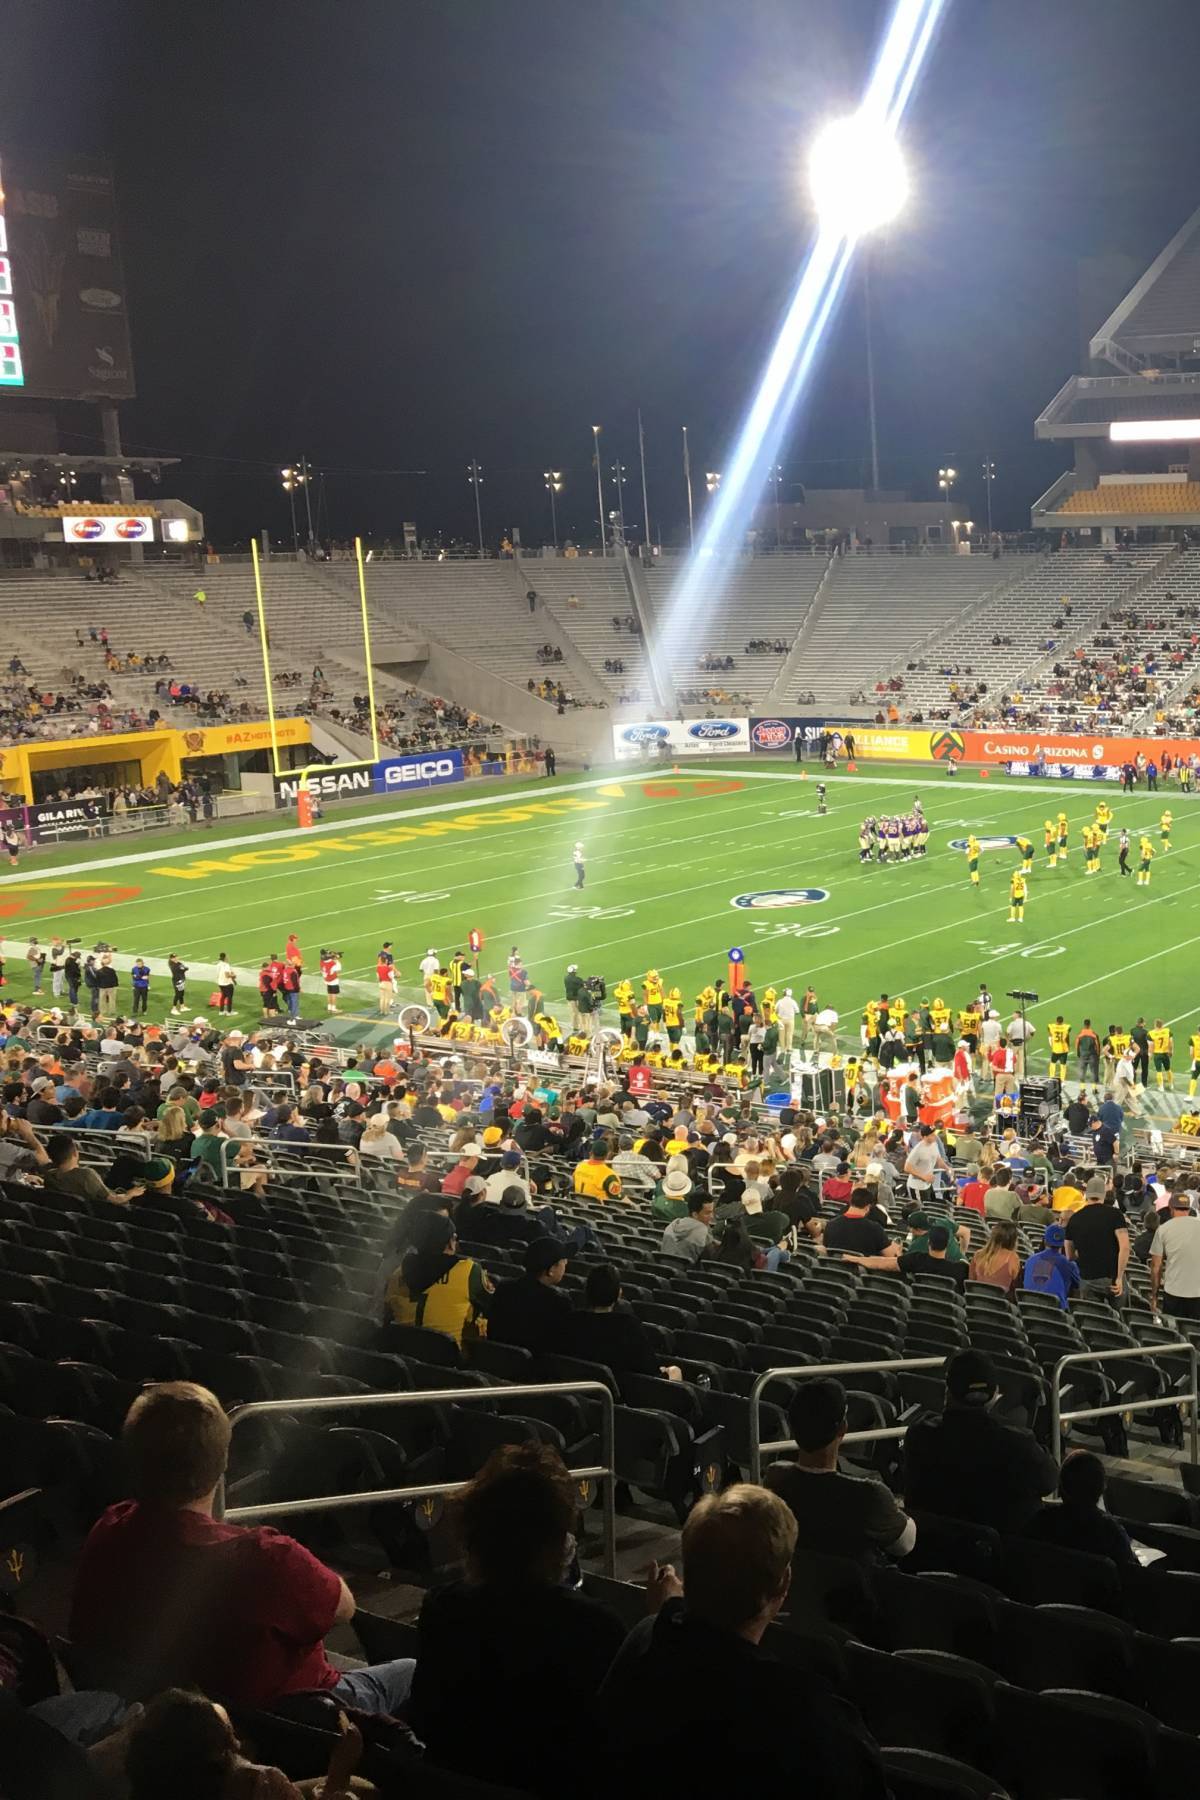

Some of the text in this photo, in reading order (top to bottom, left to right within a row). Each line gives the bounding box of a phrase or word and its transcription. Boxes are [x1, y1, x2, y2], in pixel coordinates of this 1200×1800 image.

[630, 727, 660, 742] Ford
[698, 723, 730, 737] Ford
[384, 758, 454, 784] GEICO
[280, 771, 370, 800] NSSAN
[38, 810, 64, 822] GILA
[147, 797, 611, 880] HOTSHOTS
[963, 1018, 977, 1030] 58
[1158, 1037, 1164, 1048] 7
[570, 1044, 582, 1056] 20
[1181, 1120, 1197, 1135] 22
